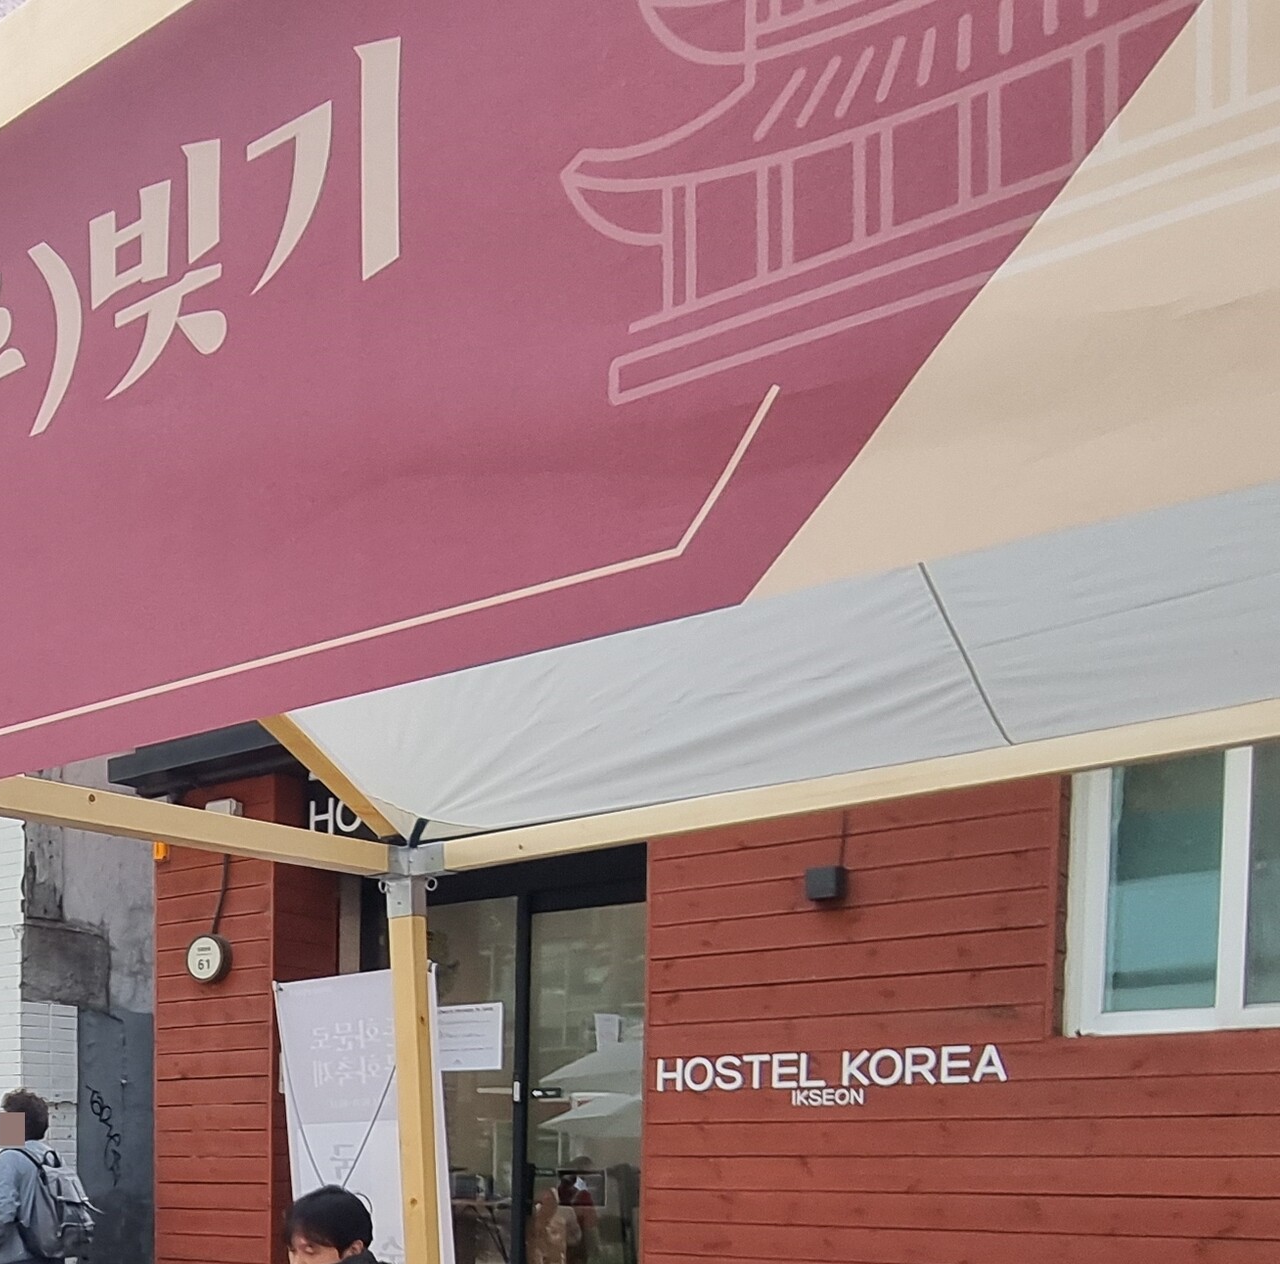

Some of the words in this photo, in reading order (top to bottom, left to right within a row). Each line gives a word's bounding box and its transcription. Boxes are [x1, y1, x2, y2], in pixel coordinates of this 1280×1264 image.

[197, 958, 210, 970] 61
[656, 1052, 826, 1091] HOSTEL
[842, 1044, 1008, 1087] KOREA
[791, 1087, 864, 1106] IKSEON
